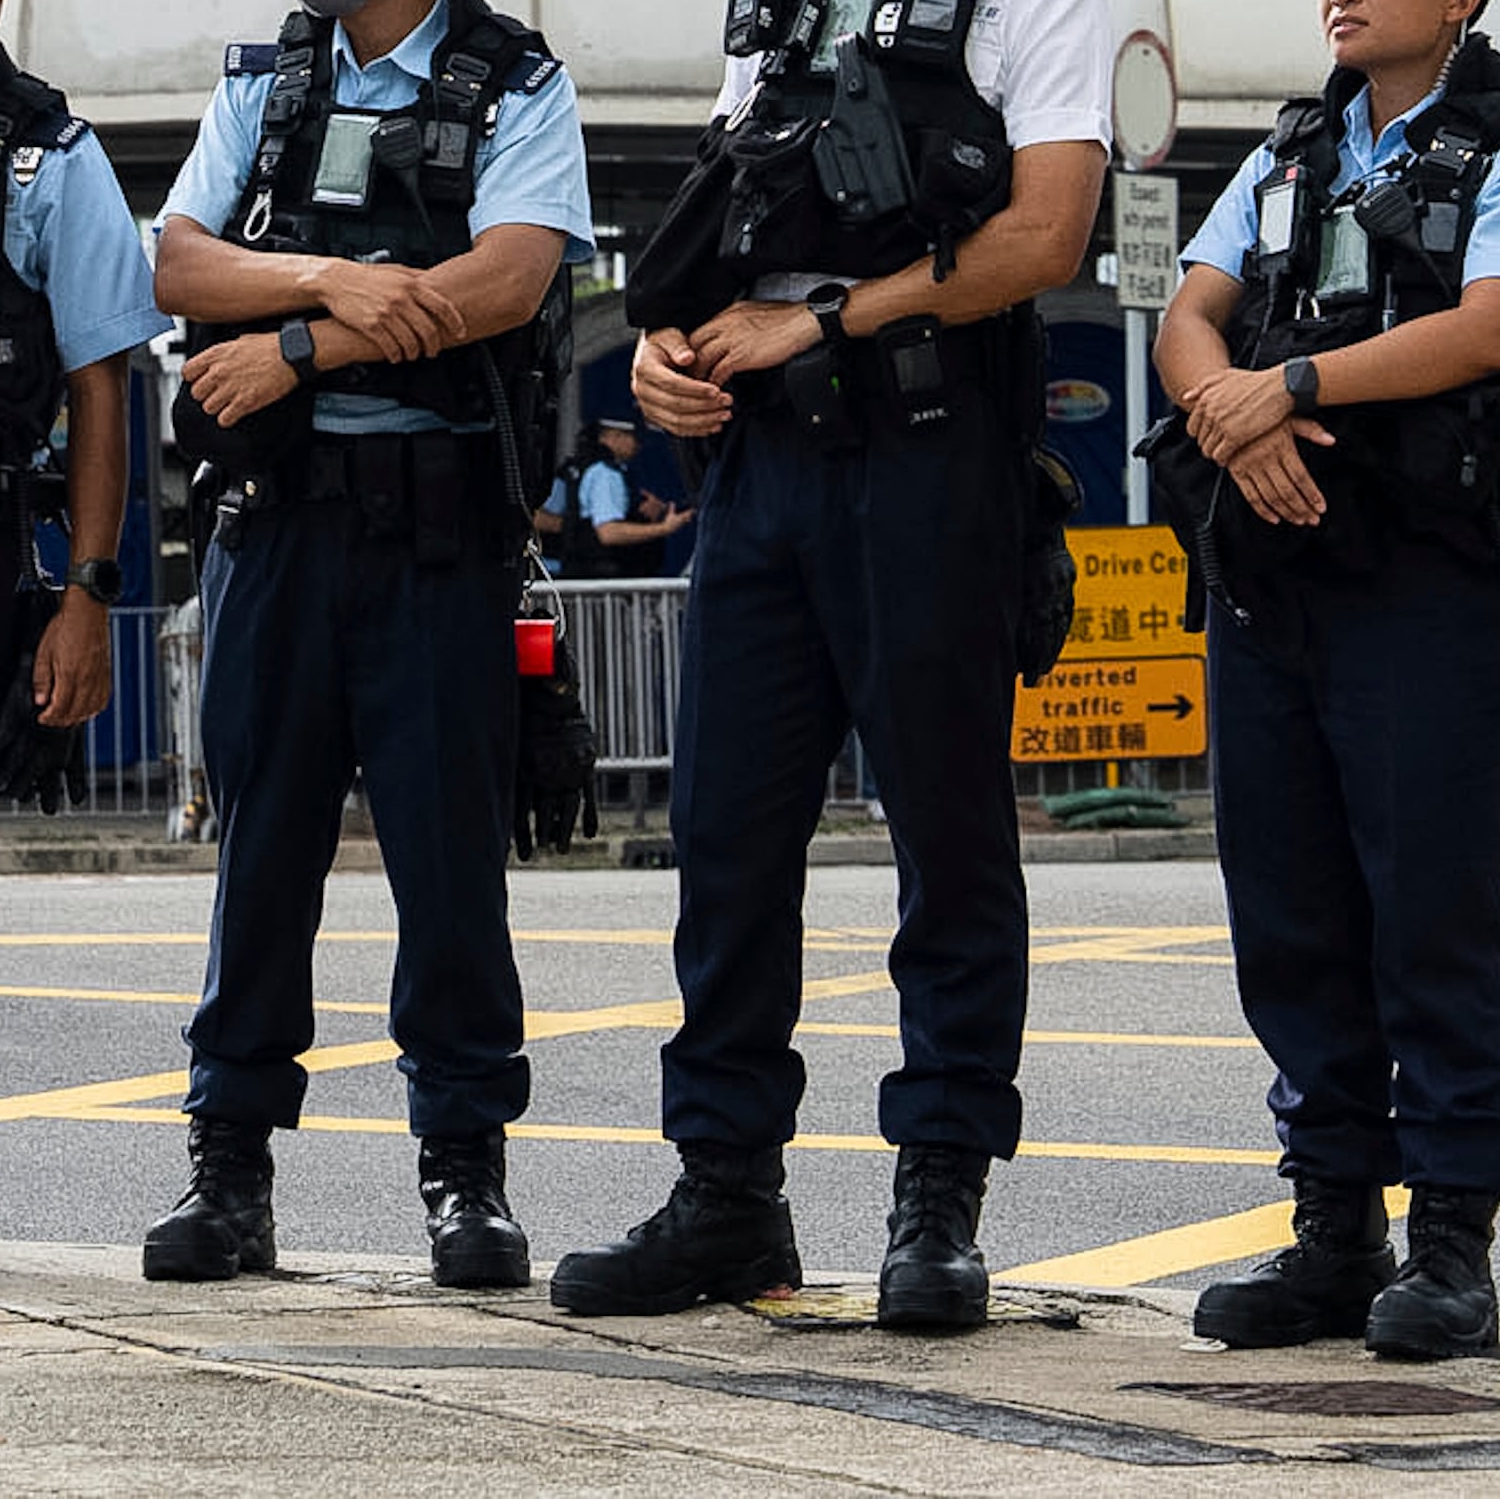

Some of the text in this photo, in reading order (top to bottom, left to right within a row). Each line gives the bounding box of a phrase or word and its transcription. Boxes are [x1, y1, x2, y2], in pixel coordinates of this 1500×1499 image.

[1085, 553, 1143, 577] Drive
[1036, 666, 1137, 688] iverted
[1042, 697, 1124, 717] traffic
[1019, 723, 1146, 754] 改道車輛
